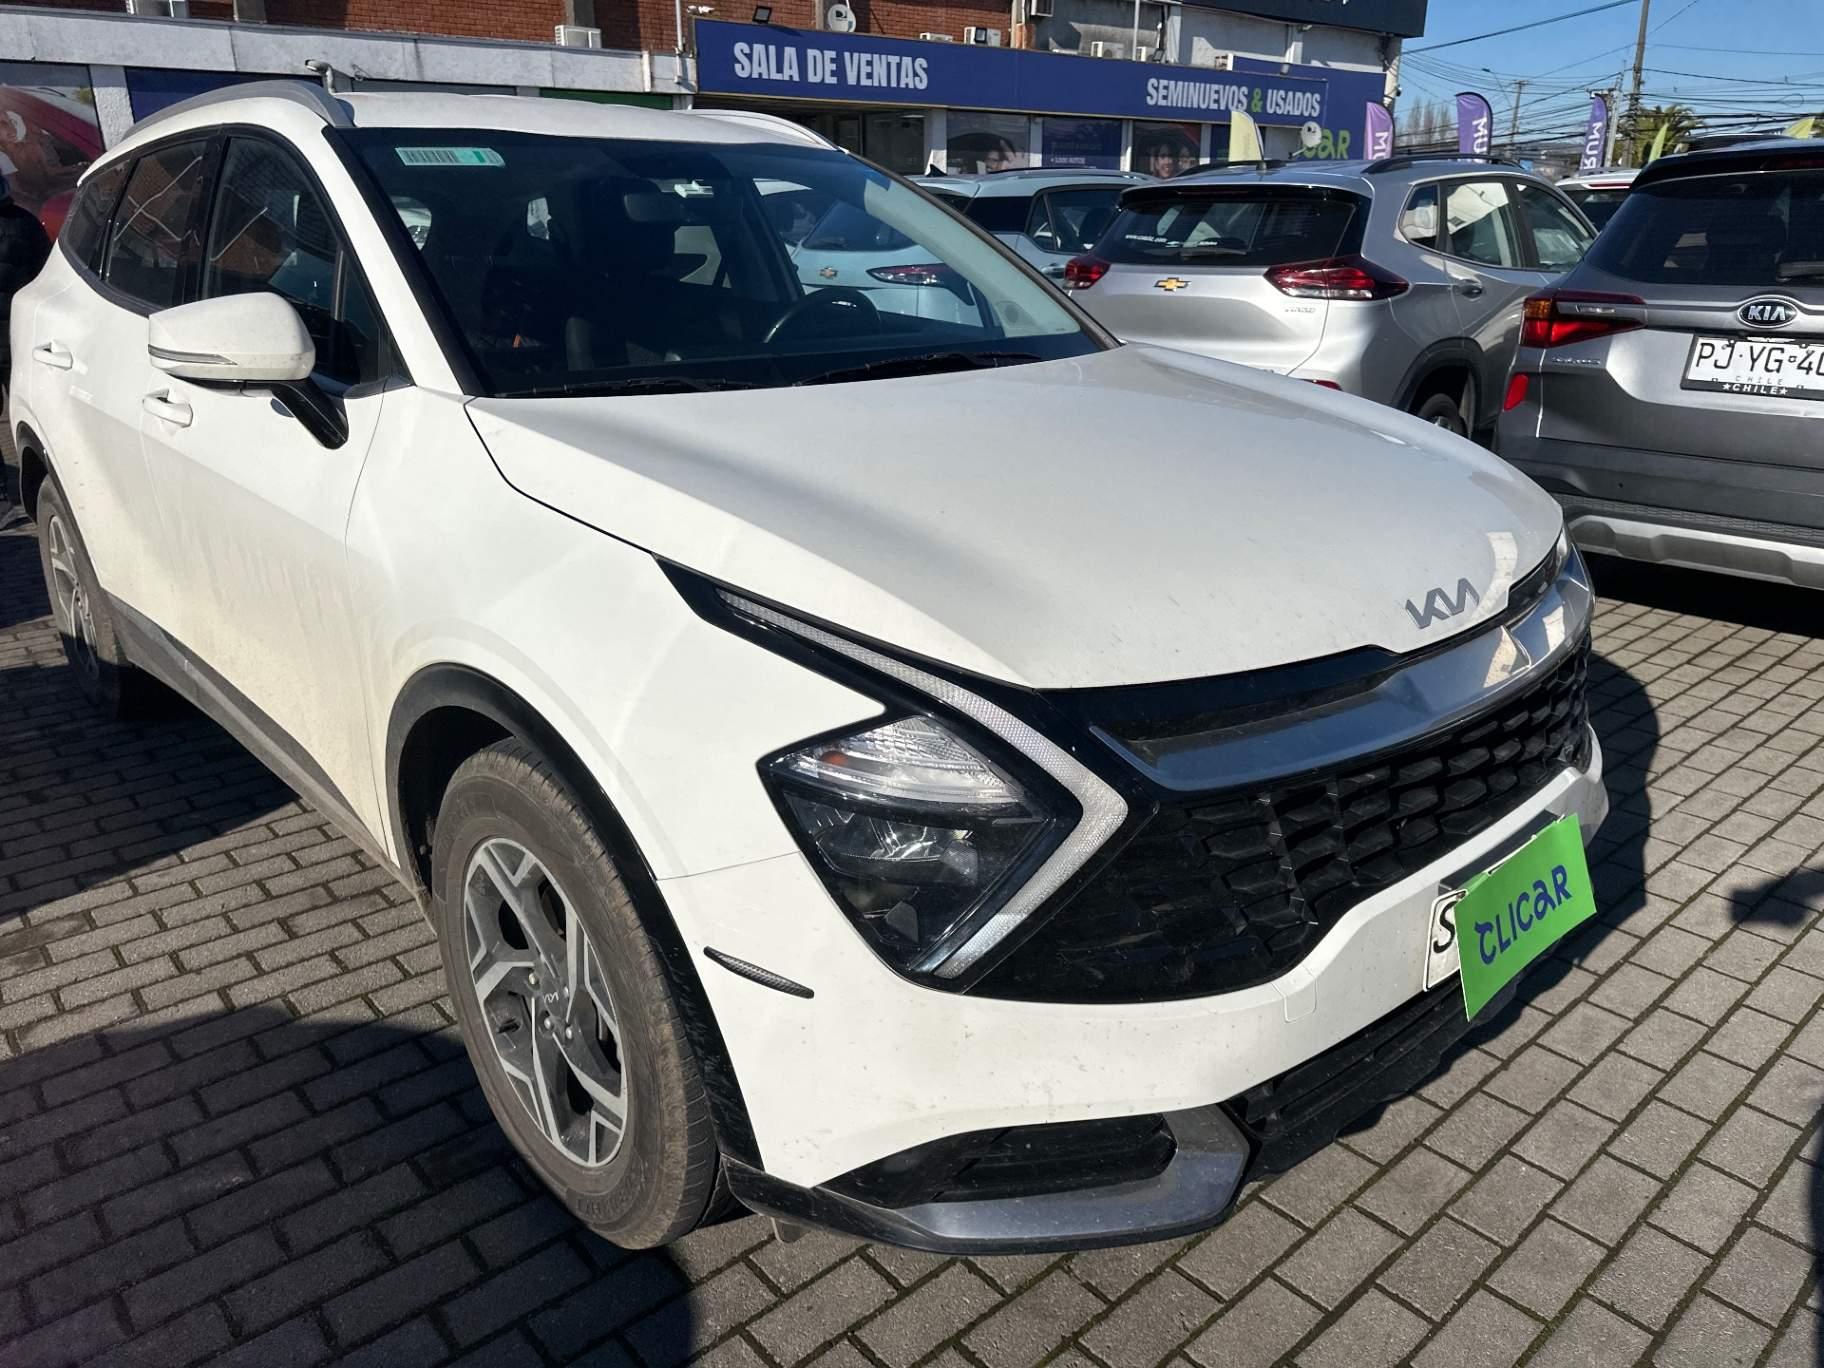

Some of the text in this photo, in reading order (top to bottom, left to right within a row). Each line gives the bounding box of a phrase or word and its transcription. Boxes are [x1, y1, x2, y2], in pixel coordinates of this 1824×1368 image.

[733, 41, 929, 90] SALA DE VENTAS
[1146, 77, 1321, 118] SEMINUEVOS & USADOS
[1747, 305, 1787, 321] KIA
[1732, 383, 1779, 395] CHILE
[1405, 577, 1480, 630] KIA
